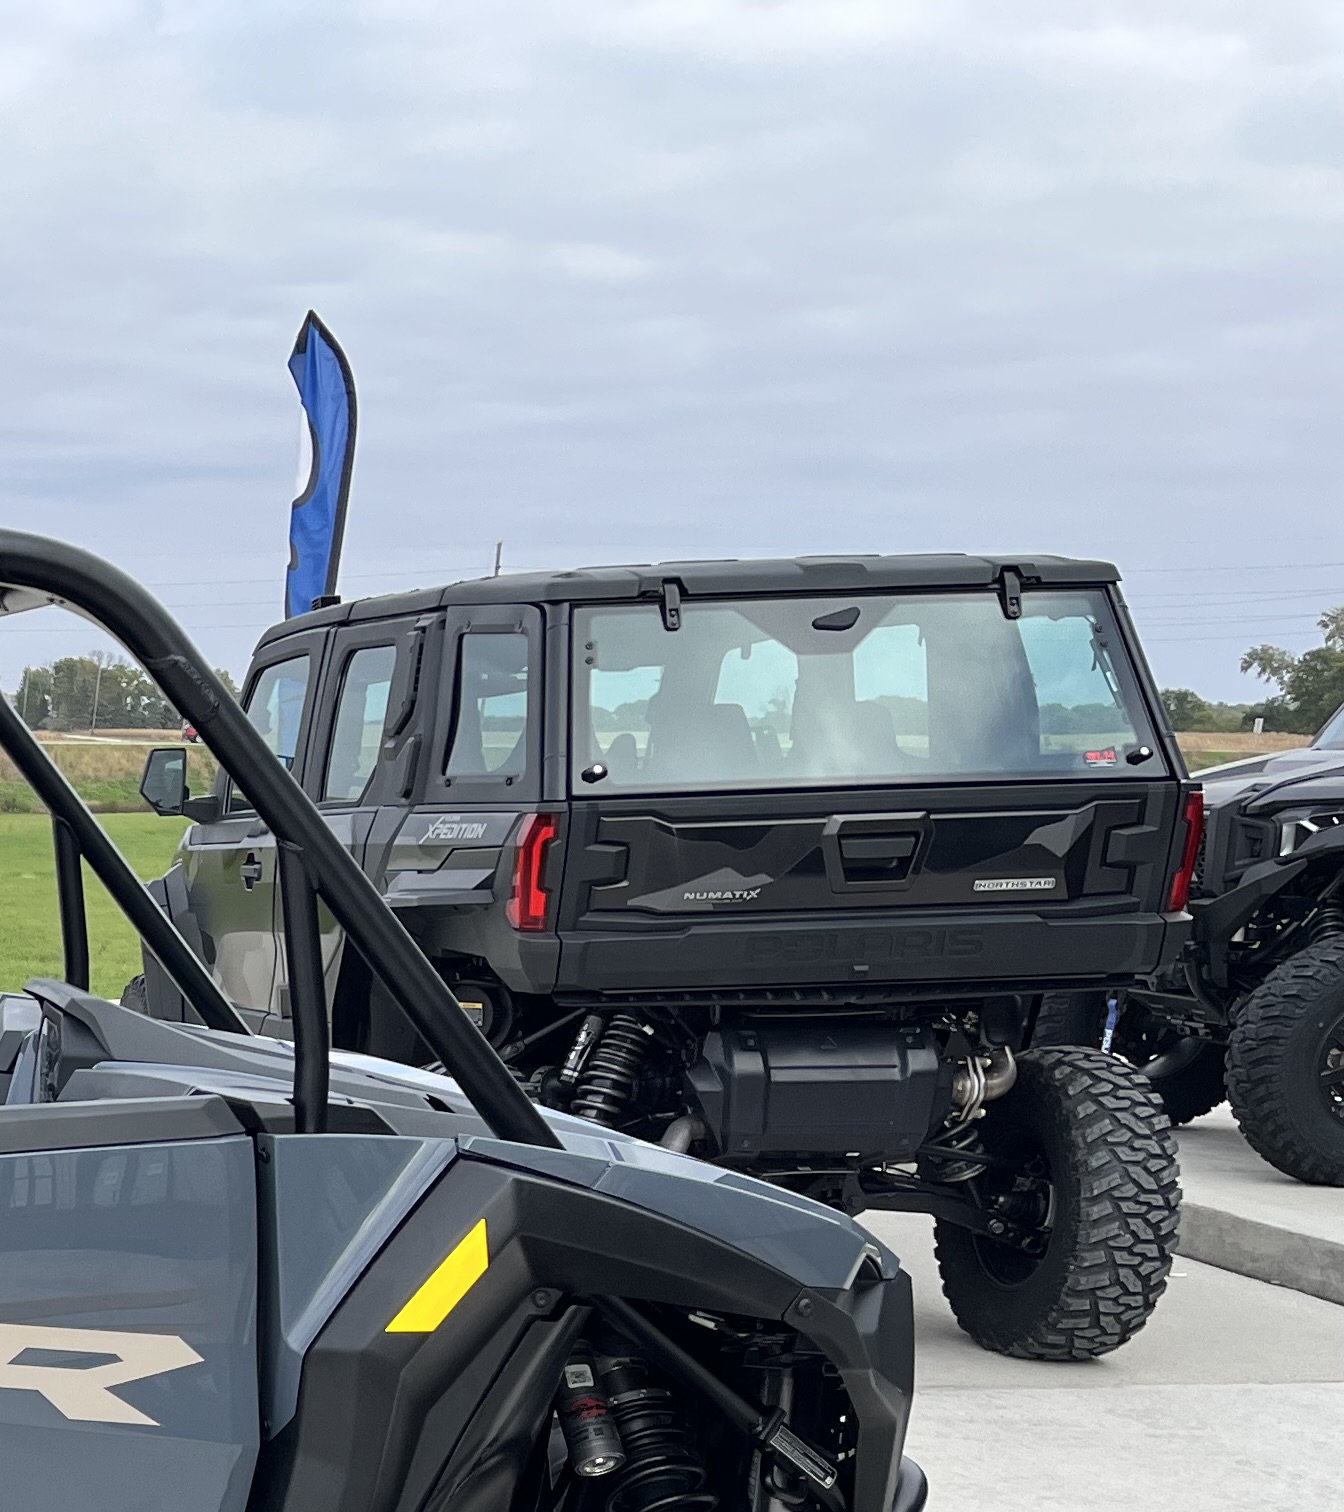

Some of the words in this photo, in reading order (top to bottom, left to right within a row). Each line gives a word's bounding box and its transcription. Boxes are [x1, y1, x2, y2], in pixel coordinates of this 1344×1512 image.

[419, 816, 487, 844] XPEDITION
[977, 880, 1052, 889] NORTHSTAR
[683, 888, 761, 900] NUMATIX
